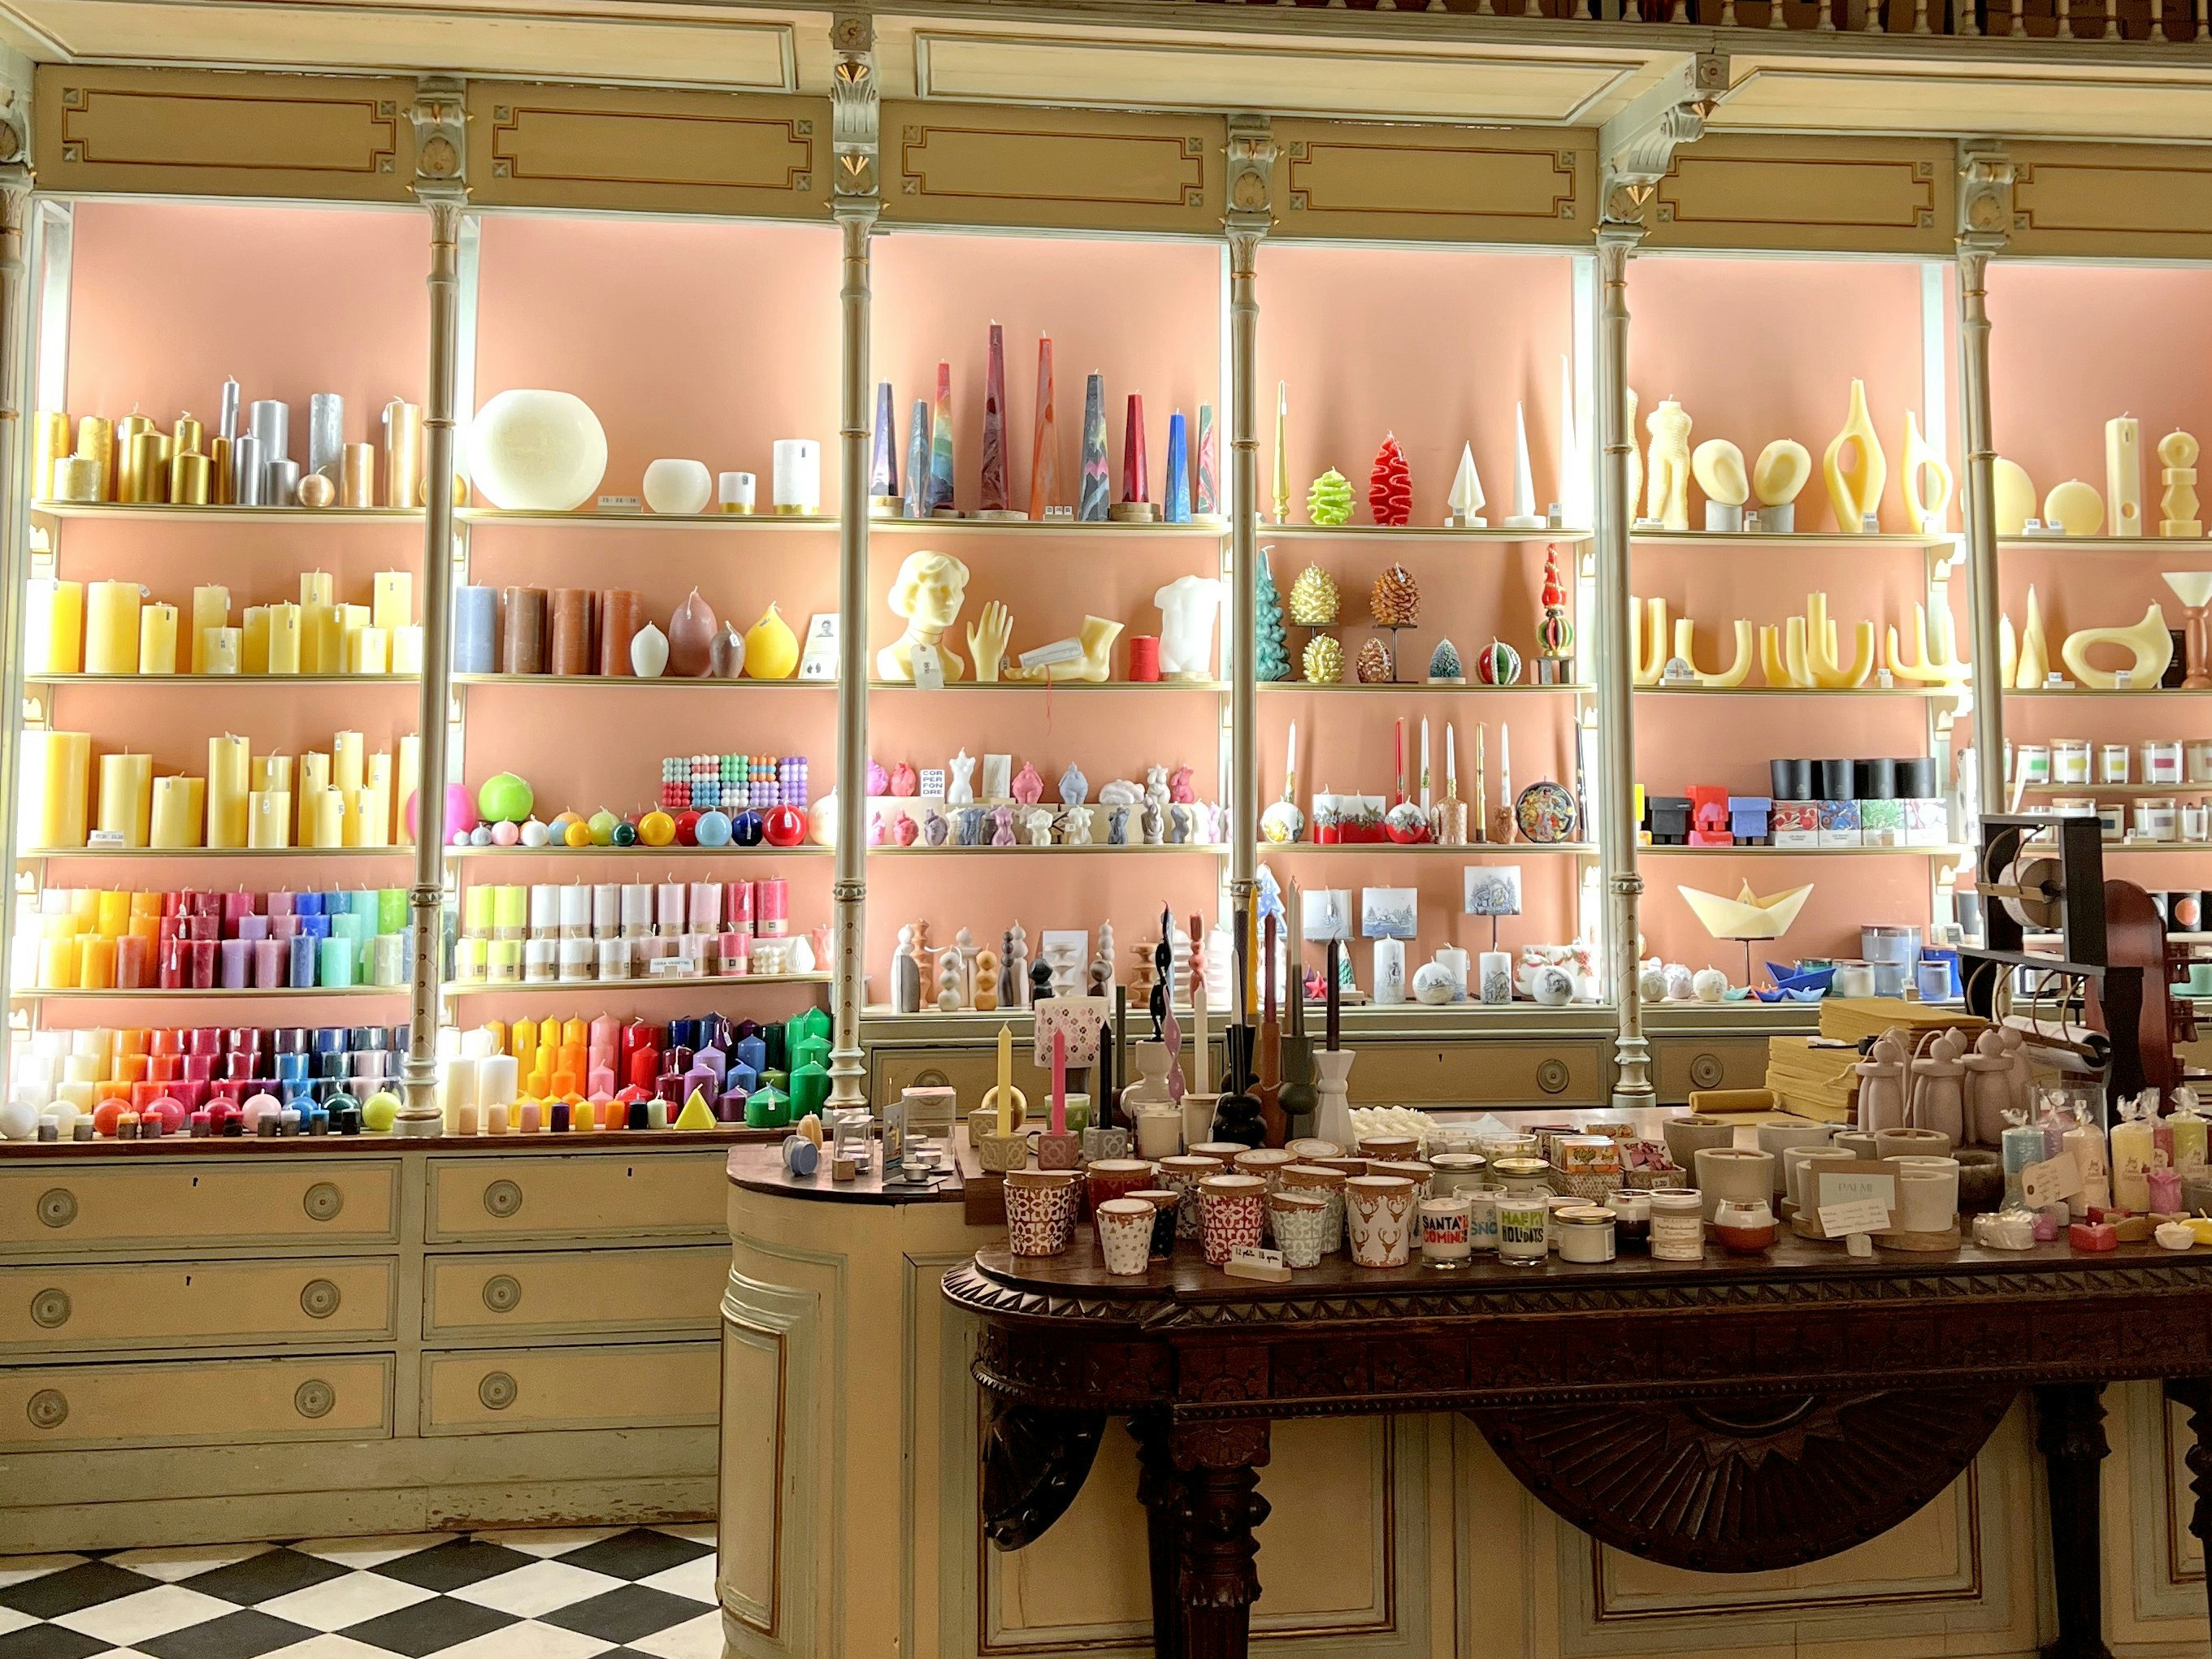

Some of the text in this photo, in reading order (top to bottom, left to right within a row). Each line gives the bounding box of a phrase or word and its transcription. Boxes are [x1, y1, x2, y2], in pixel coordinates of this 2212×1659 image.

[1422, 1215, 1461, 1231] SANTA
[1501, 1211, 1545, 1227] HAPPY
[1470, 1221, 1499, 1236] SNO
